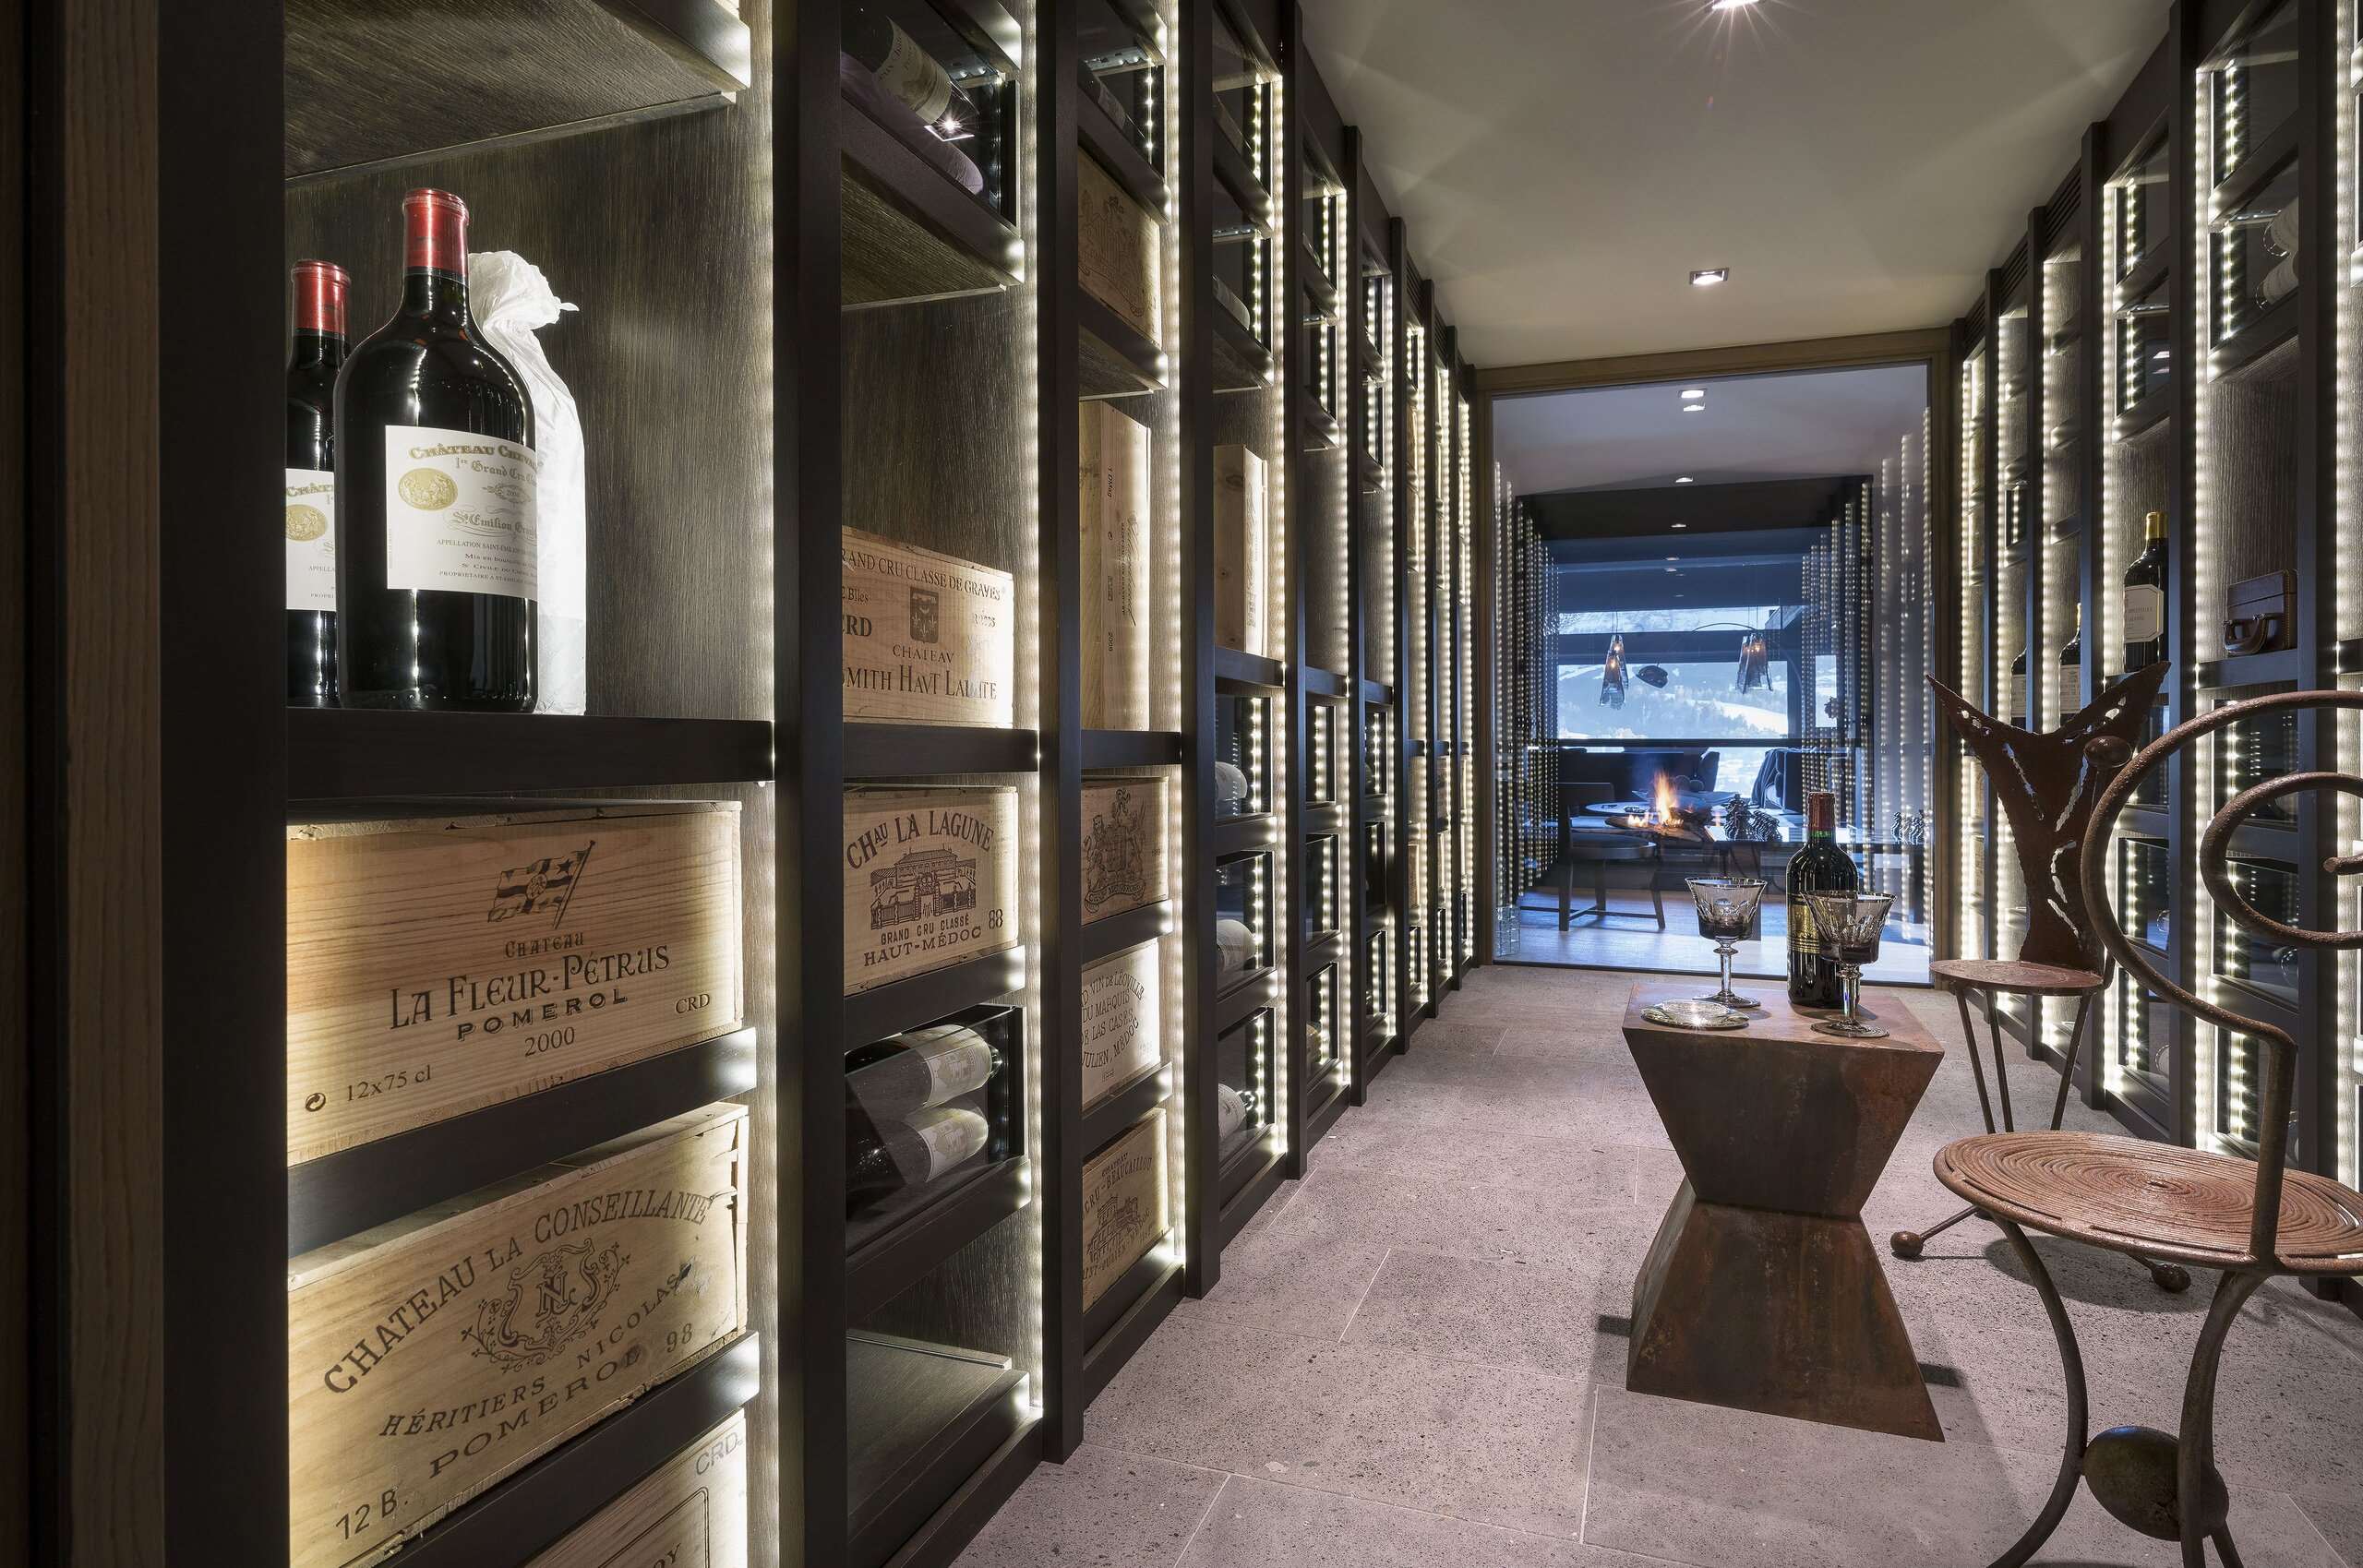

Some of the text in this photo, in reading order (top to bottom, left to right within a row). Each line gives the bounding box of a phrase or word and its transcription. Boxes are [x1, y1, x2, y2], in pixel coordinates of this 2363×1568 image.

[878, 557, 904, 577] CRU
[948, 576, 963, 592] DE
[964, 580, 1001, 601] GRAVES
[842, 666, 892, 691] MITH
[894, 813, 921, 844] LA
[929, 810, 995, 853] LAGUNE
[881, 928, 909, 946] GRAND
[917, 921, 935, 937] CRU
[988, 908, 1004, 930] 88
[505, 931, 585, 959] CHATEAU
[864, 926, 982, 967] HAUT-MÉDOC
[675, 992, 711, 1015] CRD
[1089, 976, 1104, 996] VIN
[390, 987, 432, 1030] LA
[457, 988, 628, 1041] POMEROL
[1083, 1006, 1094, 1023] DU
[1095, 988, 1130, 1018] MARQUIS
[524, 1026, 576, 1058] 2000
[1092, 1021, 1107, 1041] LAS
[346, 1073, 408, 1103] 12x75
[324, 1190, 709, 1395] CHATEAU LA CONSEILLANTE
[378, 1274, 679, 1438] HÉRITIERS NICOLAS
[429, 1322, 695, 1478] POMEROL 98
[336, 1504, 371, 1541] 12
